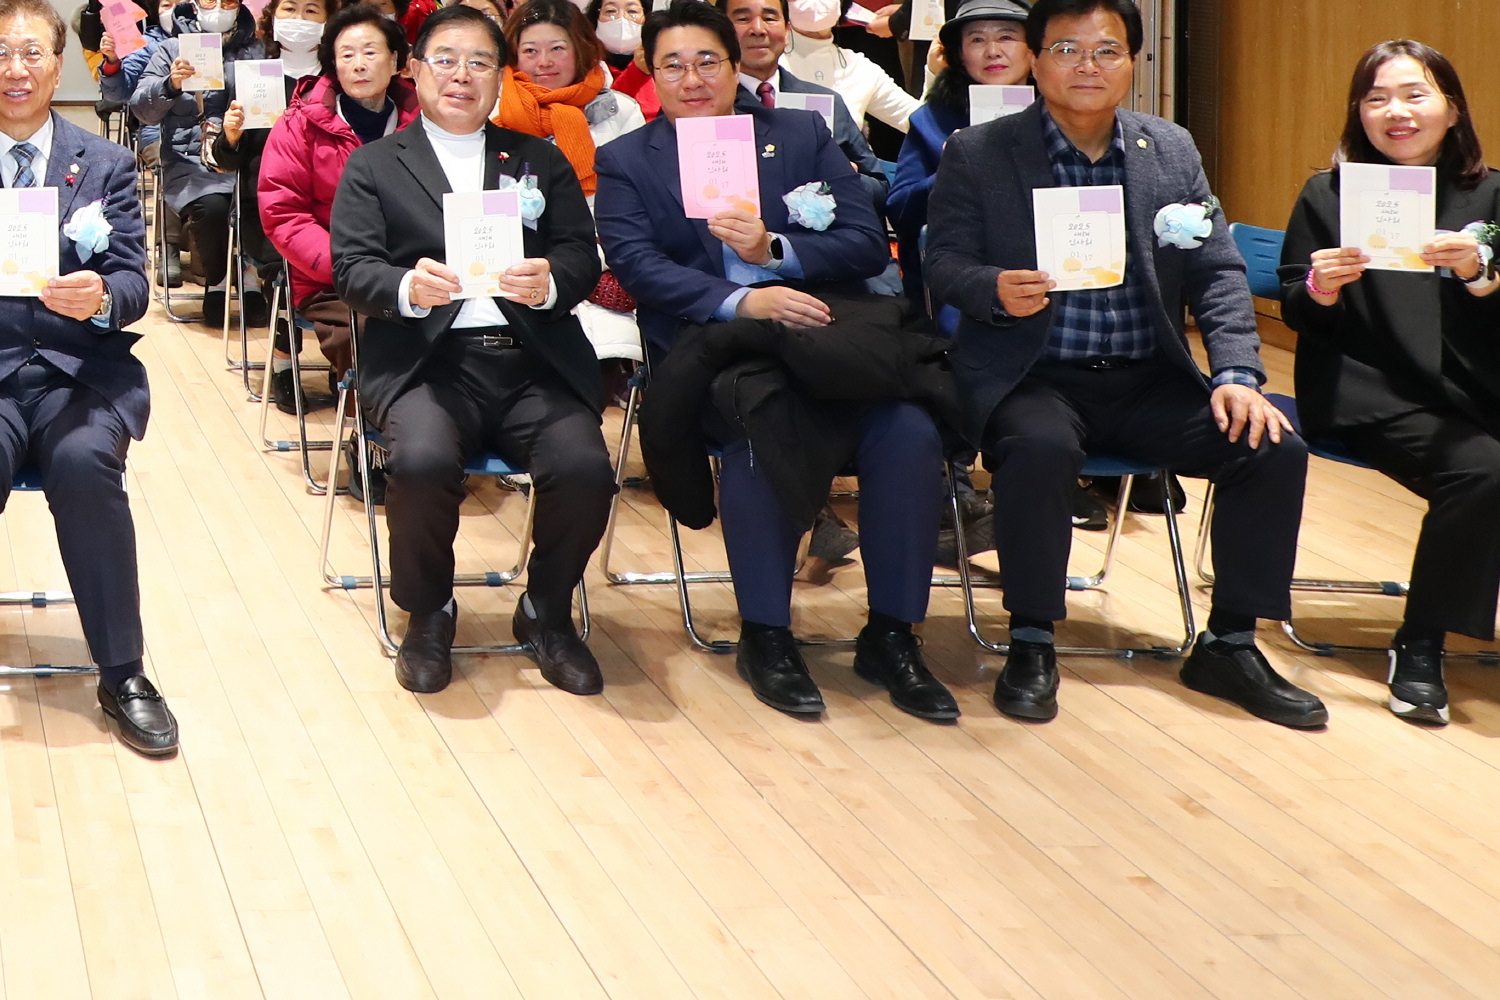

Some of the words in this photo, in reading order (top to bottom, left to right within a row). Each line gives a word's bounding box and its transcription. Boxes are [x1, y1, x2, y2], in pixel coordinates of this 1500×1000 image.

[707, 150, 727, 158] 2025
[8, 224, 28, 232] 2025
[474, 226, 493, 234] 2025
